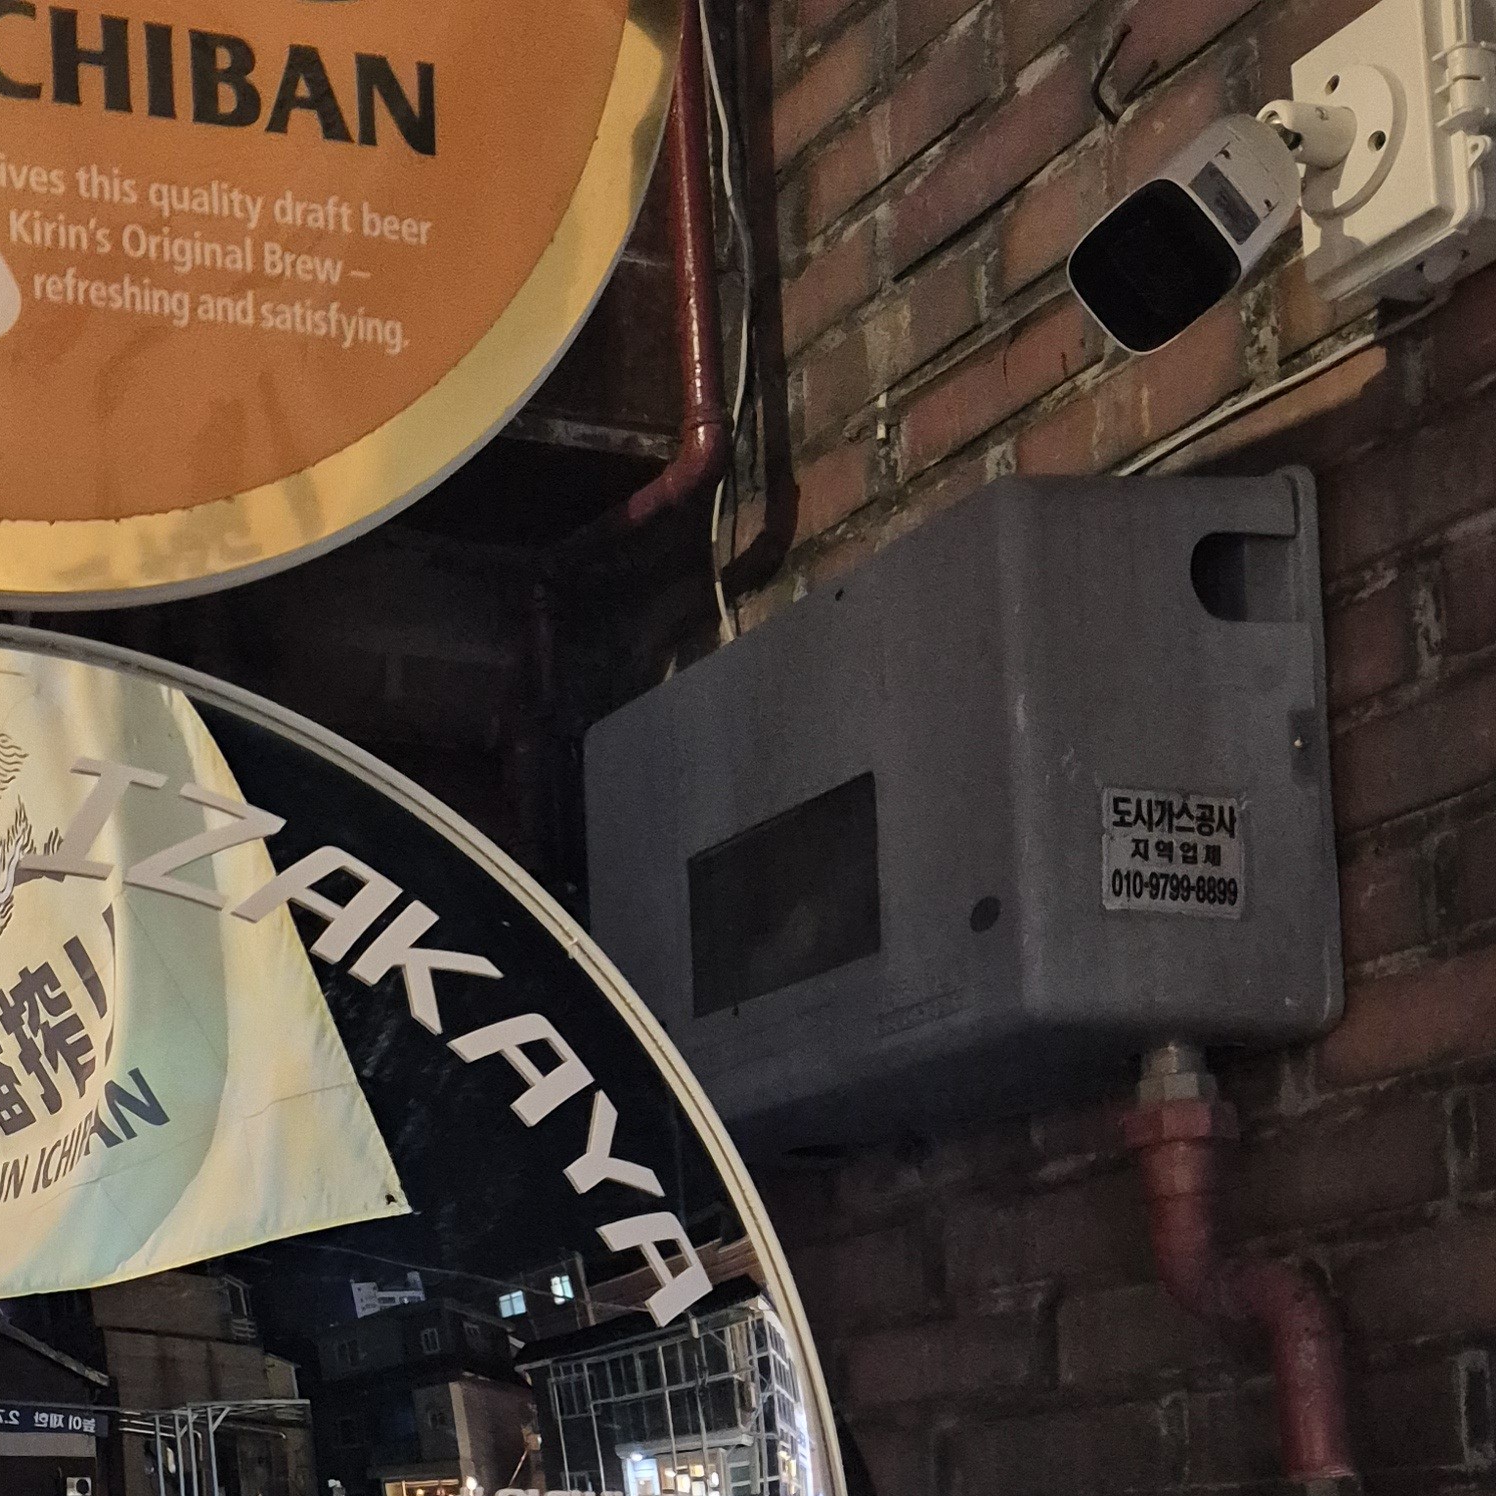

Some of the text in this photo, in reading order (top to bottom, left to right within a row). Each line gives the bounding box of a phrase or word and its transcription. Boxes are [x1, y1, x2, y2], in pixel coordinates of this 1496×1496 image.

[75, 165, 138, 204] this
[148, 181, 264, 230] quality
[273, 190, 352, 234] draft
[362, 202, 432, 246] beer
[9, 208, 112, 254] Kirin's
[121, 224, 253, 274] Original
[264, 242, 343, 285] Brew
[33, 268, 190, 327] refreshing
[198, 291, 254, 326] and
[261, 300, 409, 355] satisfying.
[1112, 796, 1237, 839] 도시가스공사
[17, 757, 713, 1328] IZAKAYA
